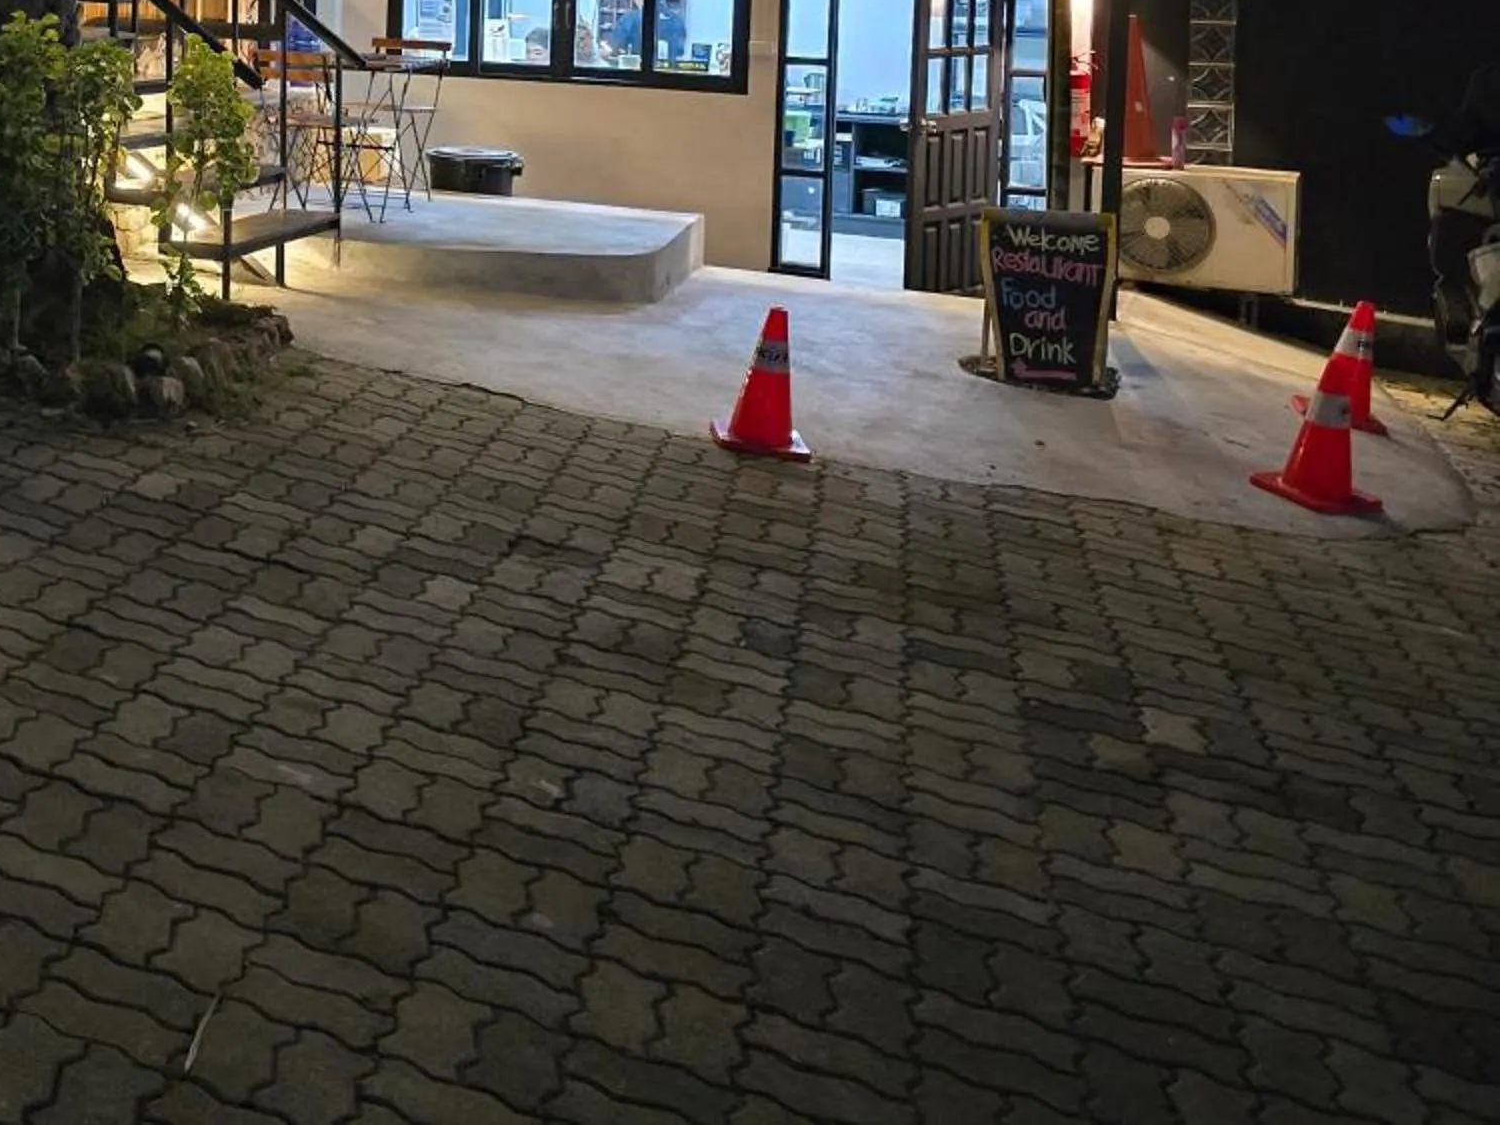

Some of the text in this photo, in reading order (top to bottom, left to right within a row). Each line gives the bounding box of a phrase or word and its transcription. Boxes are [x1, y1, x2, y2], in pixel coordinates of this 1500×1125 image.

[1005, 225, 1100, 255] Welcome
[1002, 277, 1056, 309] Food
[1025, 307, 1066, 330] and
[1009, 332, 1076, 364] Drink
